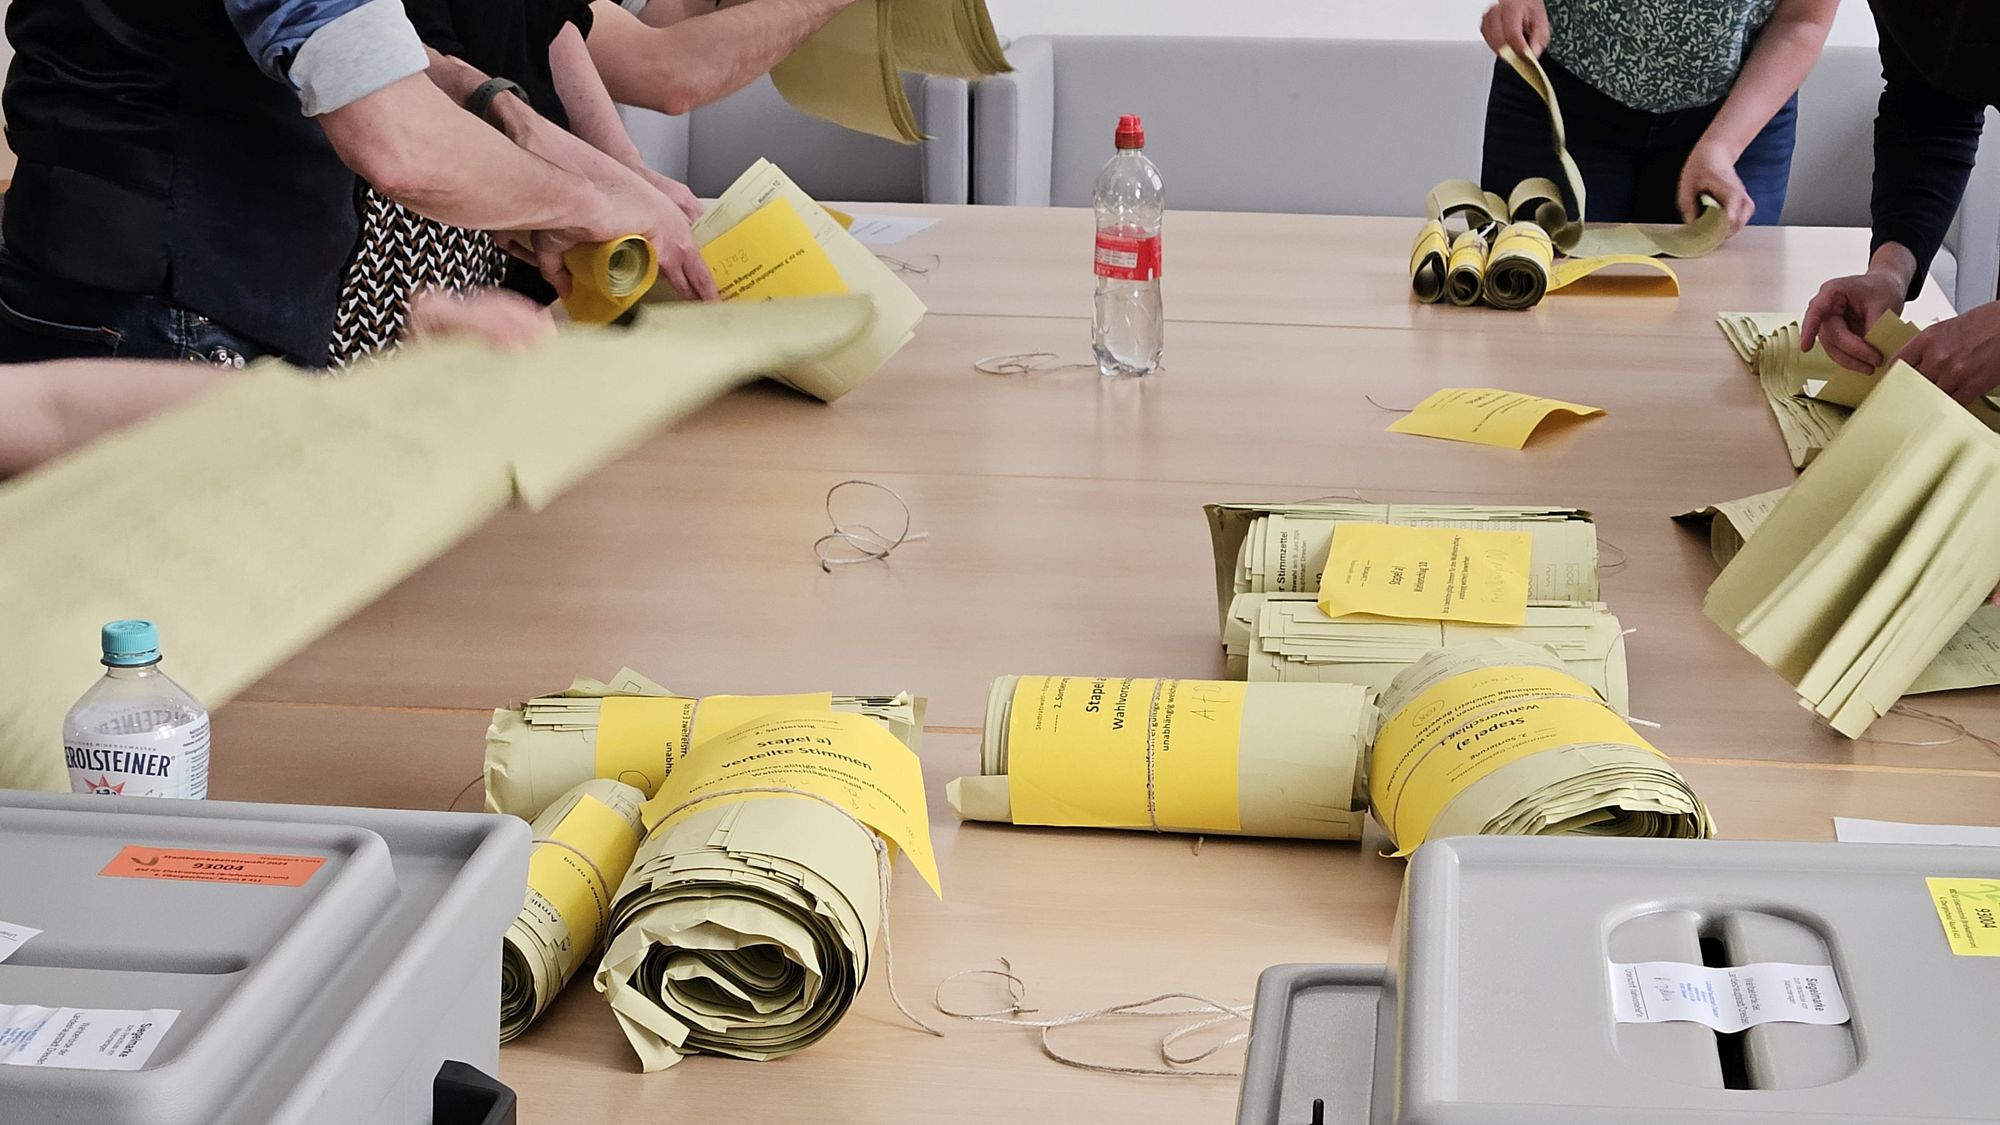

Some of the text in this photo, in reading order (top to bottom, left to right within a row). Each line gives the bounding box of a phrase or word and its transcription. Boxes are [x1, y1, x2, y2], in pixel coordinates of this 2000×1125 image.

[1277, 531, 1288, 585] Stimmzettel
[1086, 682, 1106, 713] Stapel
[1457, 700, 1496, 717] Stimmen
[765, 724, 816, 733] Sortierung
[1163, 699, 1175, 752] unabhängig
[1426, 725, 1441, 738] den
[1443, 717, 1455, 726] für
[1447, 704, 1540, 741] Wahlvorschlag
[756, 735, 833, 749] Stapel a)
[1456, 717, 1525, 751] Stapel a)
[721, 747, 873, 772] verteilte Stimmen
[1470, 737, 1516, 760] Sortierung
[818, 765, 860, 782] Stimmen
[861, 780, 875, 790] auf
[831, 775, 862, 790] verteilt
[192, 862, 245, 871] 93004
[1974, 907, 1998, 929] 93004
[1804, 977, 1826, 1012] Siegelmarke
[118, 1023, 153, 1058] Siegelmarke
